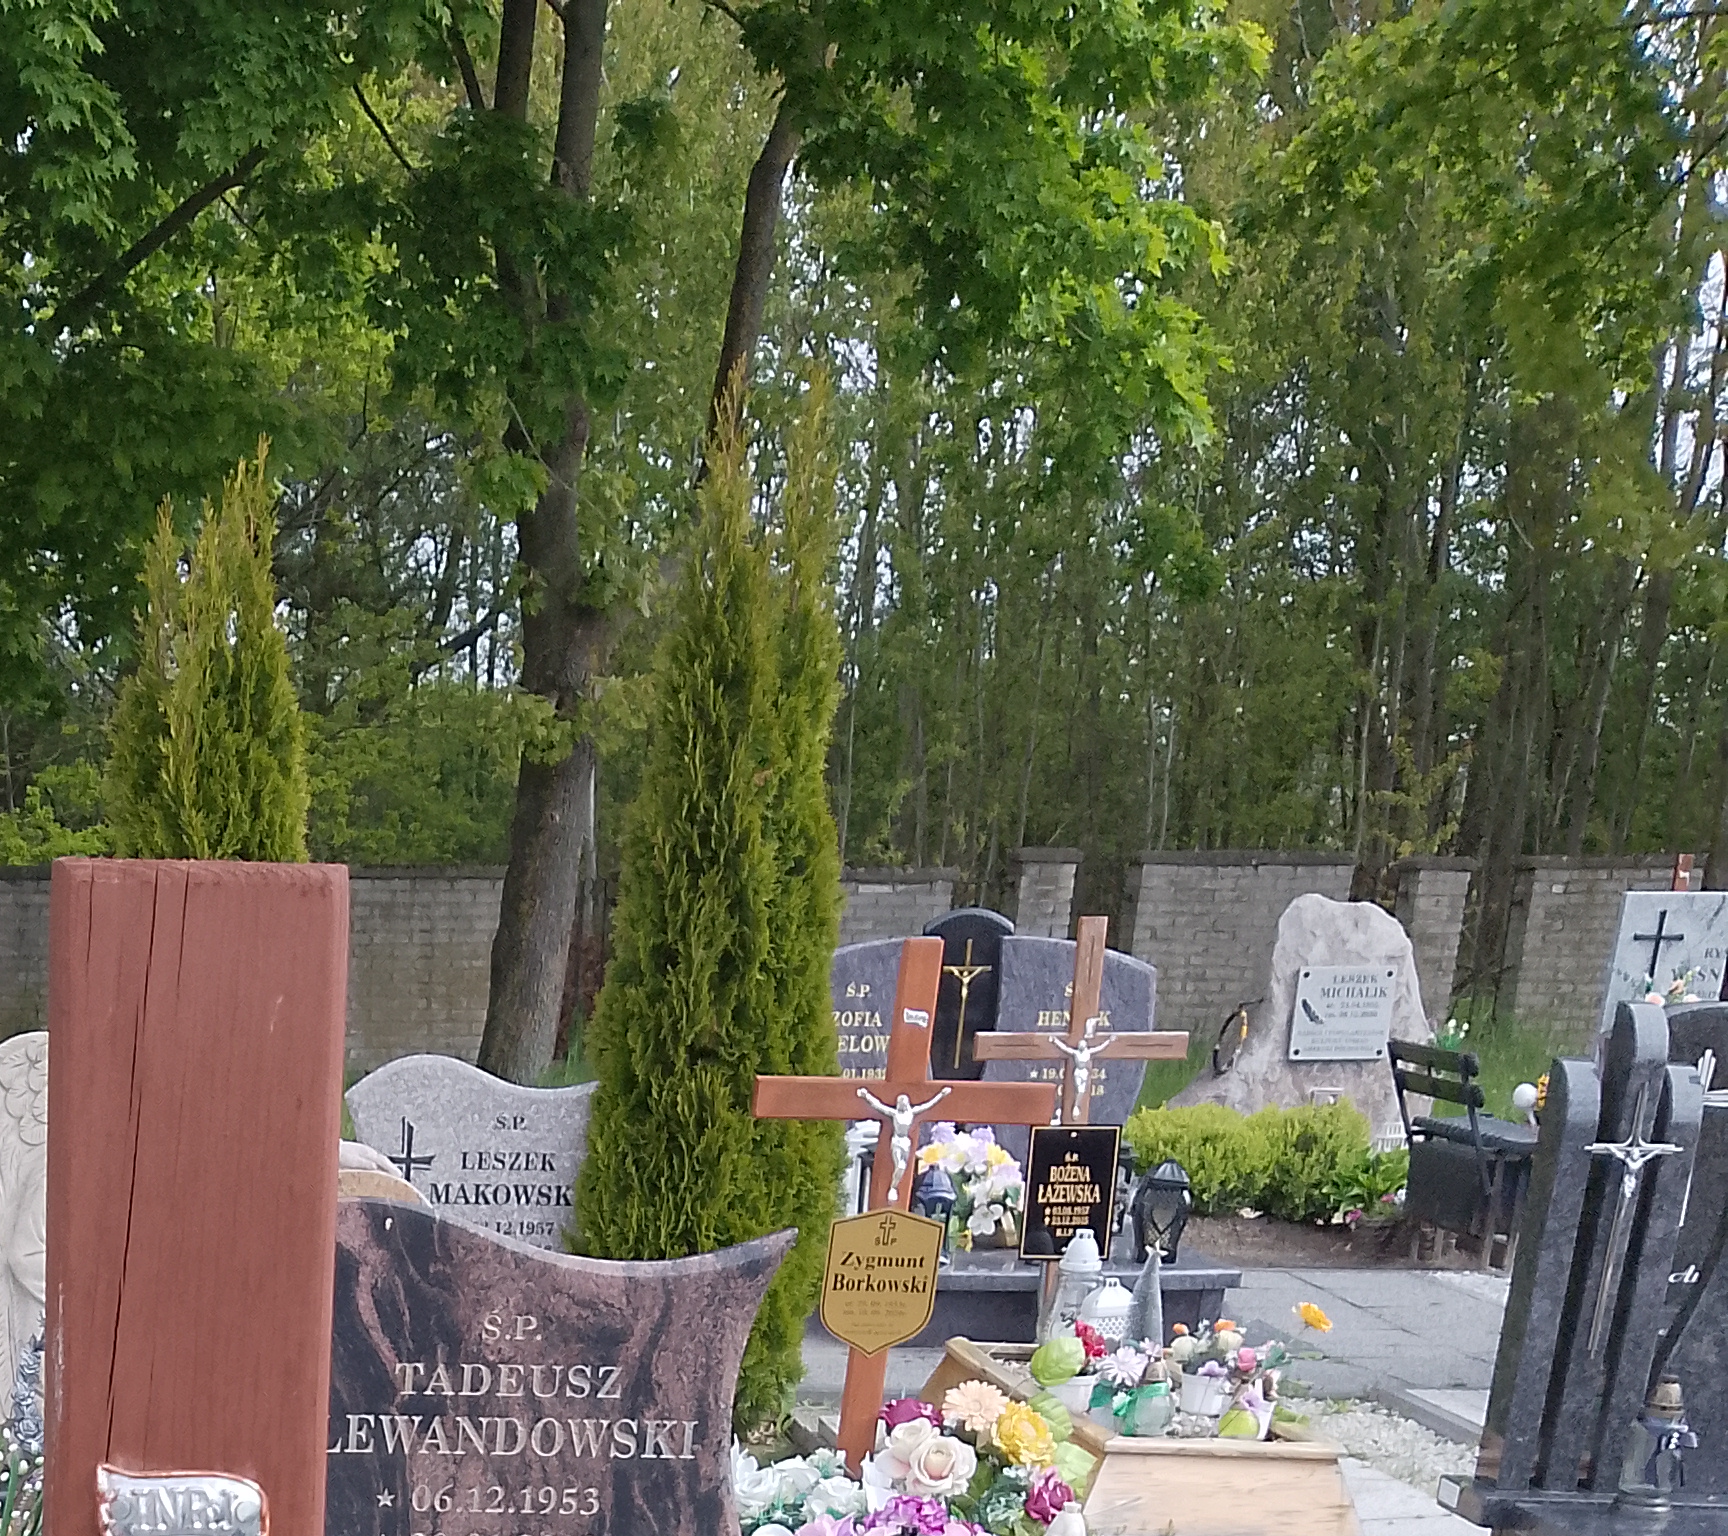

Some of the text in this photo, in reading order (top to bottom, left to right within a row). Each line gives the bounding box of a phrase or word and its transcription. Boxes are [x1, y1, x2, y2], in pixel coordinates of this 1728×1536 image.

[1321, 986, 1388, 998] MICHALIK
[832, 1011, 883, 1027] ZOFIA
[461, 1151, 556, 1171] LESZEK
[1050, 1163, 1090, 1182] BOŻENA
[429, 1183, 574, 1206] MAKOWSK
[840, 1252, 924, 1270] Zygmunt
[832, 1273, 928, 1293] Borkowski
[481, 1312, 543, 1341] Ś.P.
[394, 1362, 623, 1399] TADEUSZ
[411, 1484, 601, 1515] 06.12.1953
